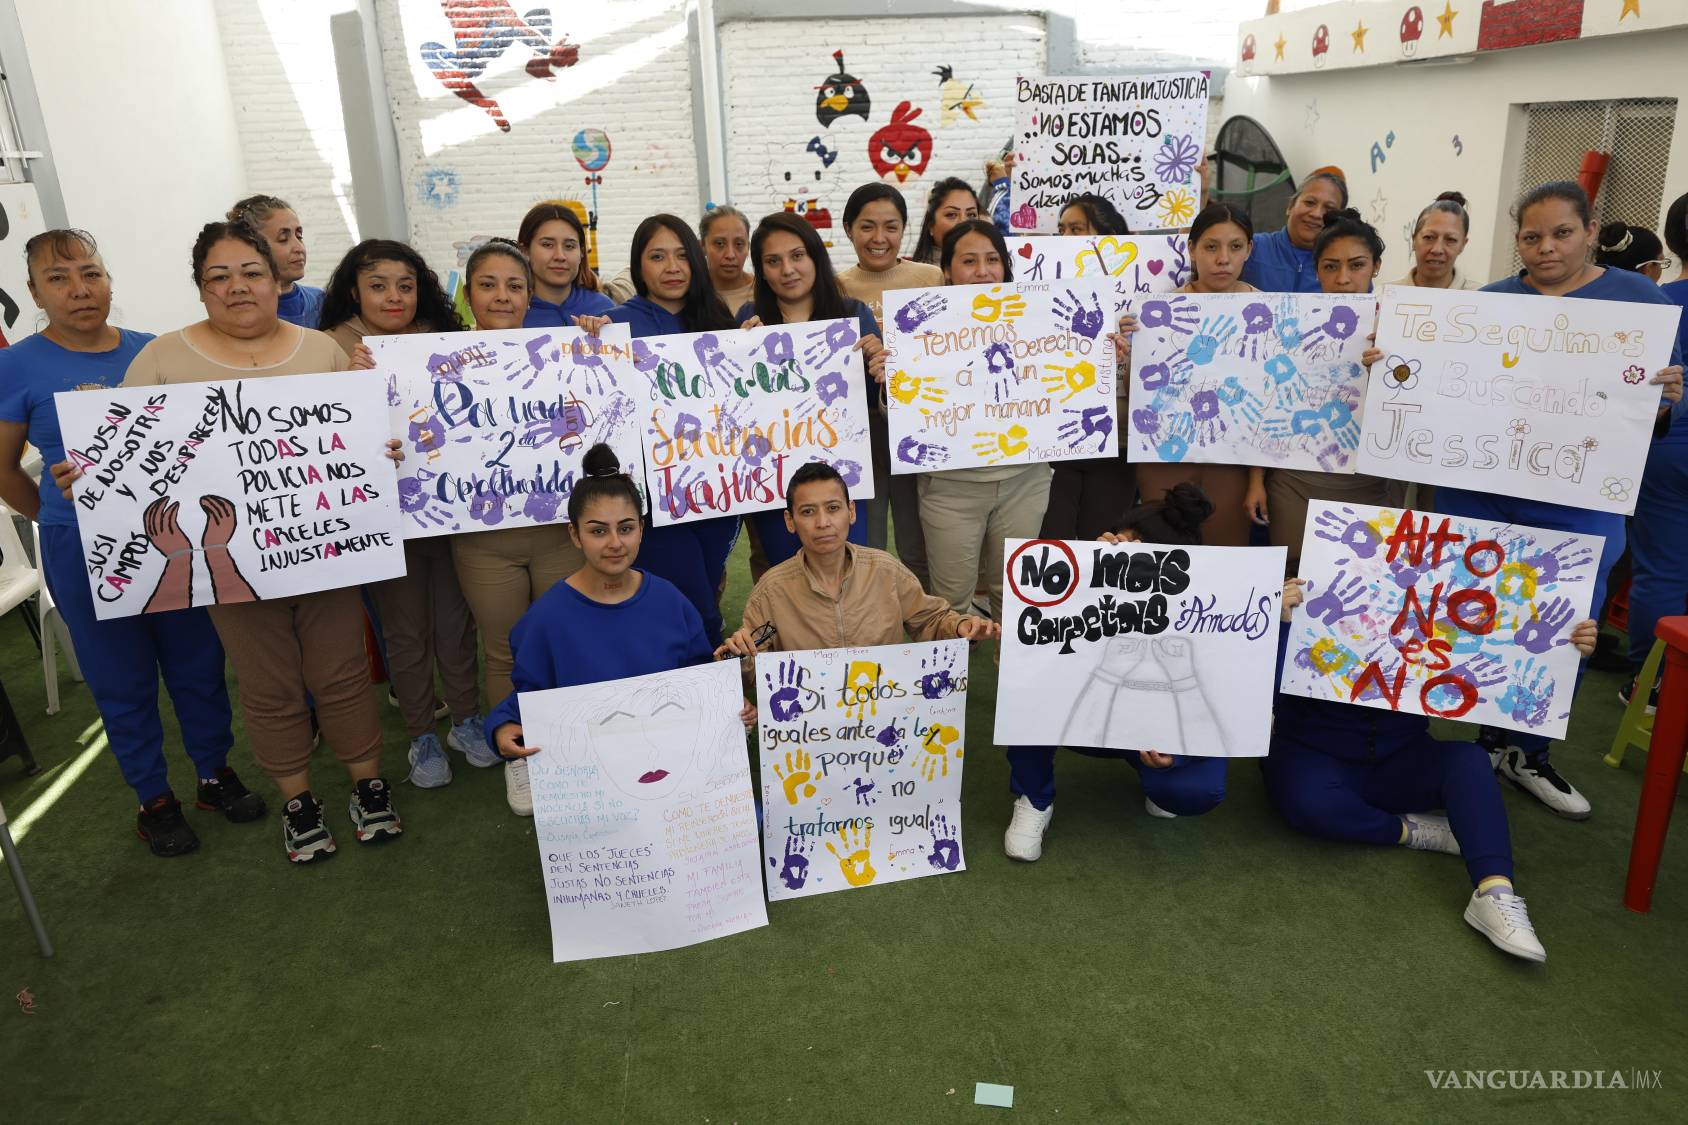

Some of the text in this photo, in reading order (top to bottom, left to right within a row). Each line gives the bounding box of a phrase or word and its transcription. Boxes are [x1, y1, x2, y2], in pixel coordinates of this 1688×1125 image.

[1018, 80, 1065, 104] BASTA
[1068, 82, 1088, 102] DE
[1093, 81, 1137, 102] TANTA
[1068, 109, 1162, 138] ESTAMOS
[914, 323, 1017, 356] Tenemos
[1395, 304, 1437, 341] Te
[1443, 305, 1644, 368] Seguimos
[651, 362, 715, 400] No
[1017, 364, 1038, 381] un
[1437, 361, 1607, 417] Buscando
[268, 402, 352, 433] SOMOS
[431, 380, 497, 428] Por
[925, 402, 975, 436] mejor
[78, 393, 167, 511] DE NOSOTRAS
[150, 385, 222, 497] DESAPARECEN
[228, 433, 346, 466] TODAS LA
[652, 404, 838, 465] Sentencias
[1366, 402, 1589, 484] Jessica
[140, 440, 174, 476] NOS
[237, 462, 366, 494] POLICIA NOS
[437, 460, 573, 503] Oportunida
[246, 483, 379, 525] METE A LAS
[253, 517, 350, 550] CARCELES
[260, 532, 393, 572] INJUSTAMENTE
[89, 534, 117, 578] SUSI
[97, 531, 151, 603] CAMPOS
[1391, 582, 1497, 637] NO
[1402, 639, 1453, 671] es
[798, 665, 826, 713] Si
[837, 663, 907, 705] todos
[1350, 661, 1478, 718] NO
[763, 722, 831, 750] iguales
[837, 720, 875, 742] ante
[914, 717, 940, 745] ley
[892, 780, 915, 796] no
[889, 805, 930, 834] igual
[550, 863, 572, 874] DEN
[595, 874, 611, 887] NO
